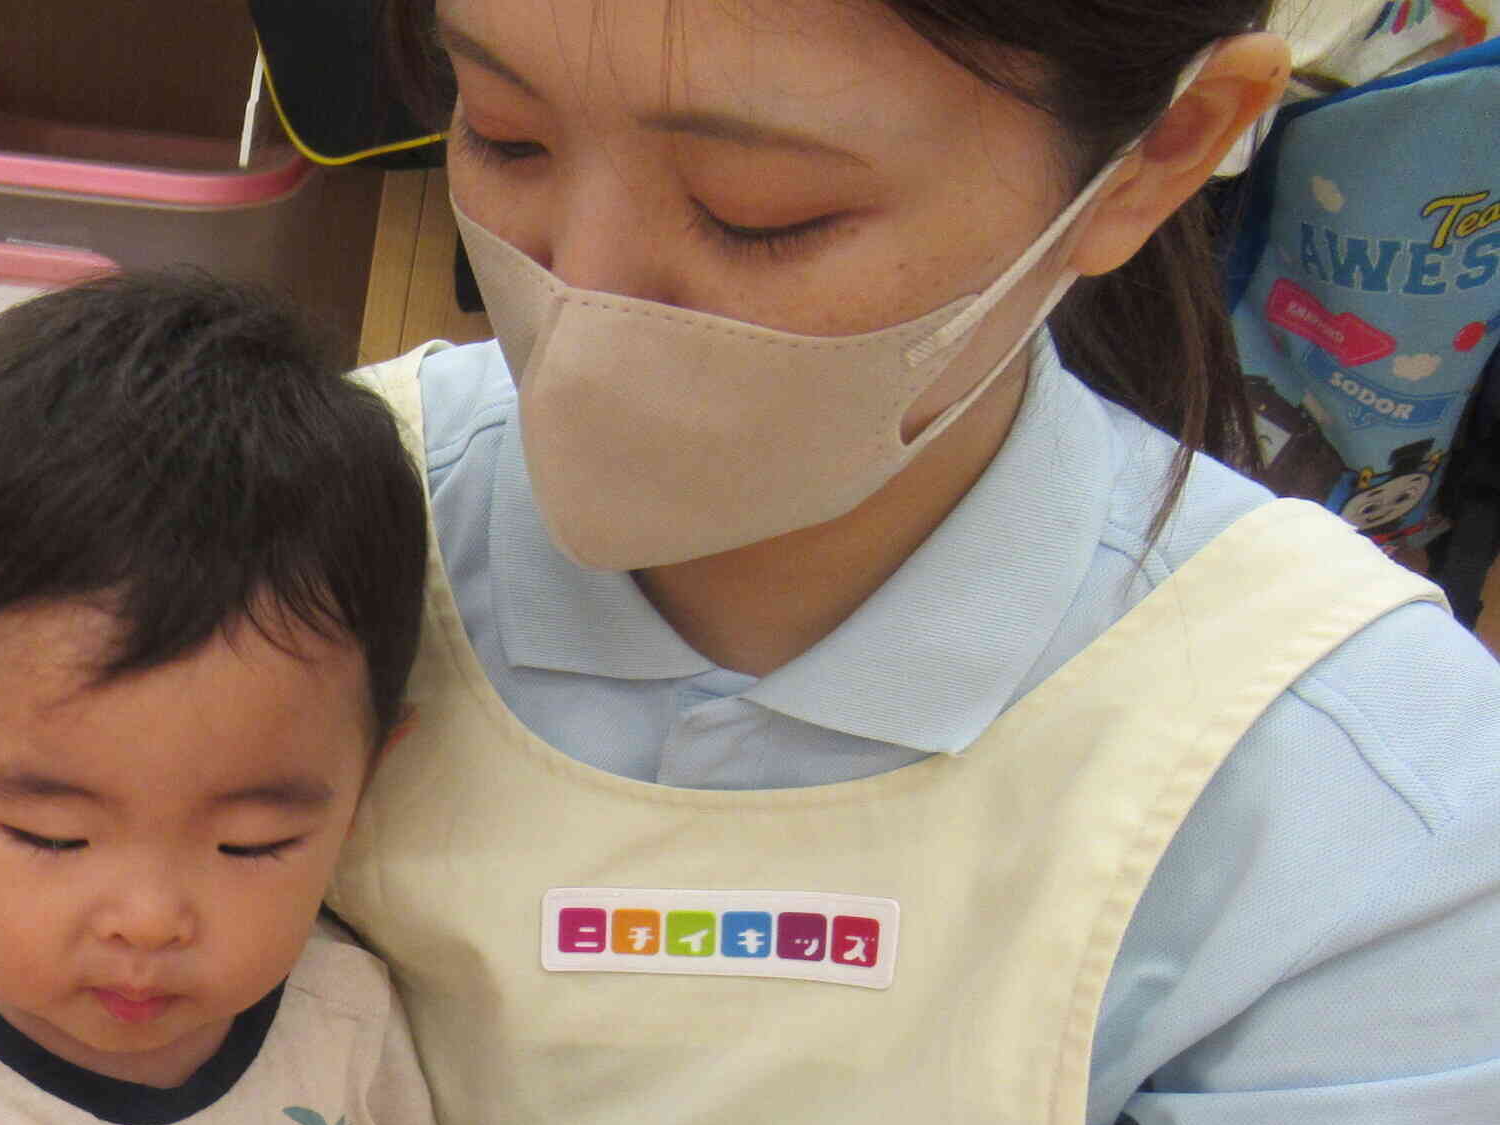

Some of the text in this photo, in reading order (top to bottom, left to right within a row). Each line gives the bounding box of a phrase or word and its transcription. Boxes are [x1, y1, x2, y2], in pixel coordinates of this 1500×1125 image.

[573, 924, 878, 964] ニチイキッズ
